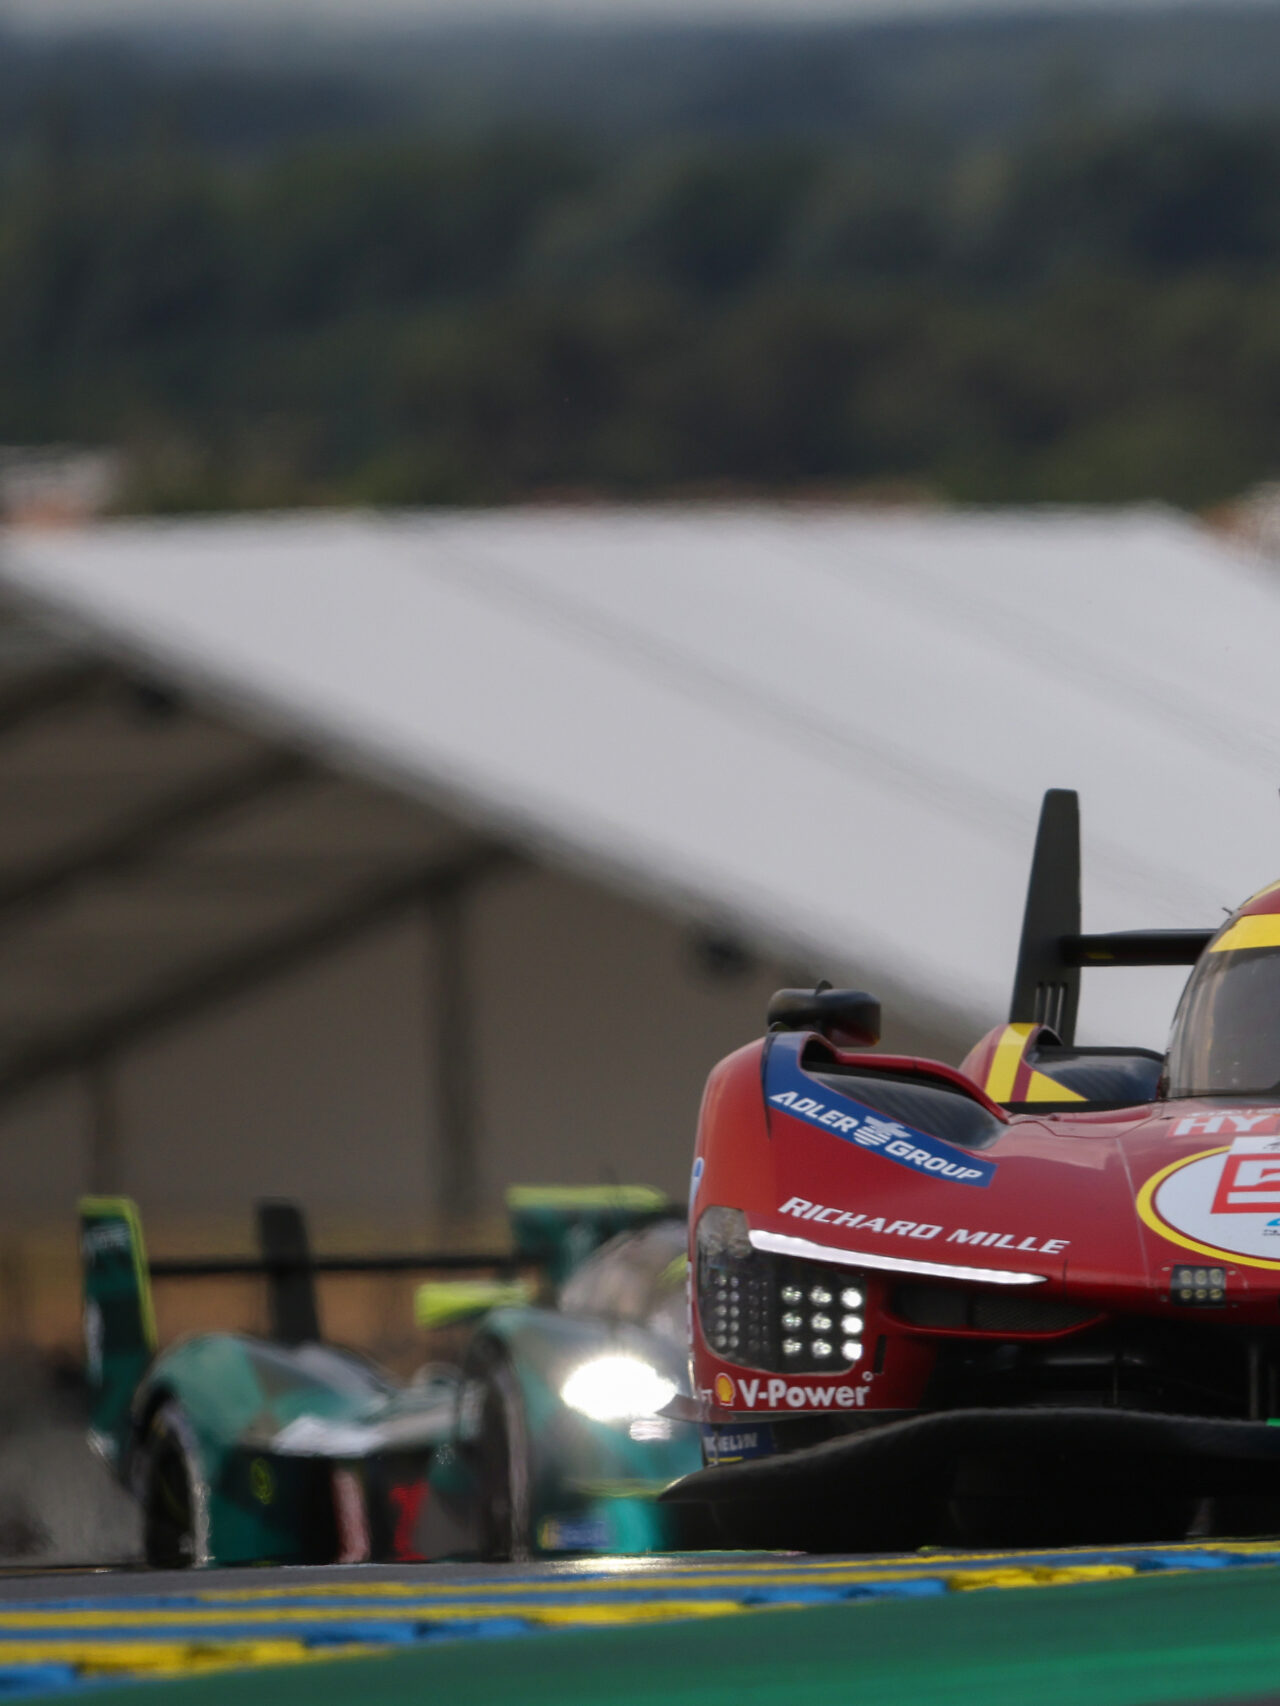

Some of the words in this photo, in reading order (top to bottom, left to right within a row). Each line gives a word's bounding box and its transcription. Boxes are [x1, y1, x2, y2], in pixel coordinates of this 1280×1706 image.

[768, 1090, 857, 1134] ADLER
[884, 1140, 983, 1182] GROUP
[1174, 1115, 1272, 1136] HY
[778, 1197, 943, 1240] RICHARD
[946, 1228, 1071, 1254] MILLE
[737, 1378, 871, 1408] V-Power
